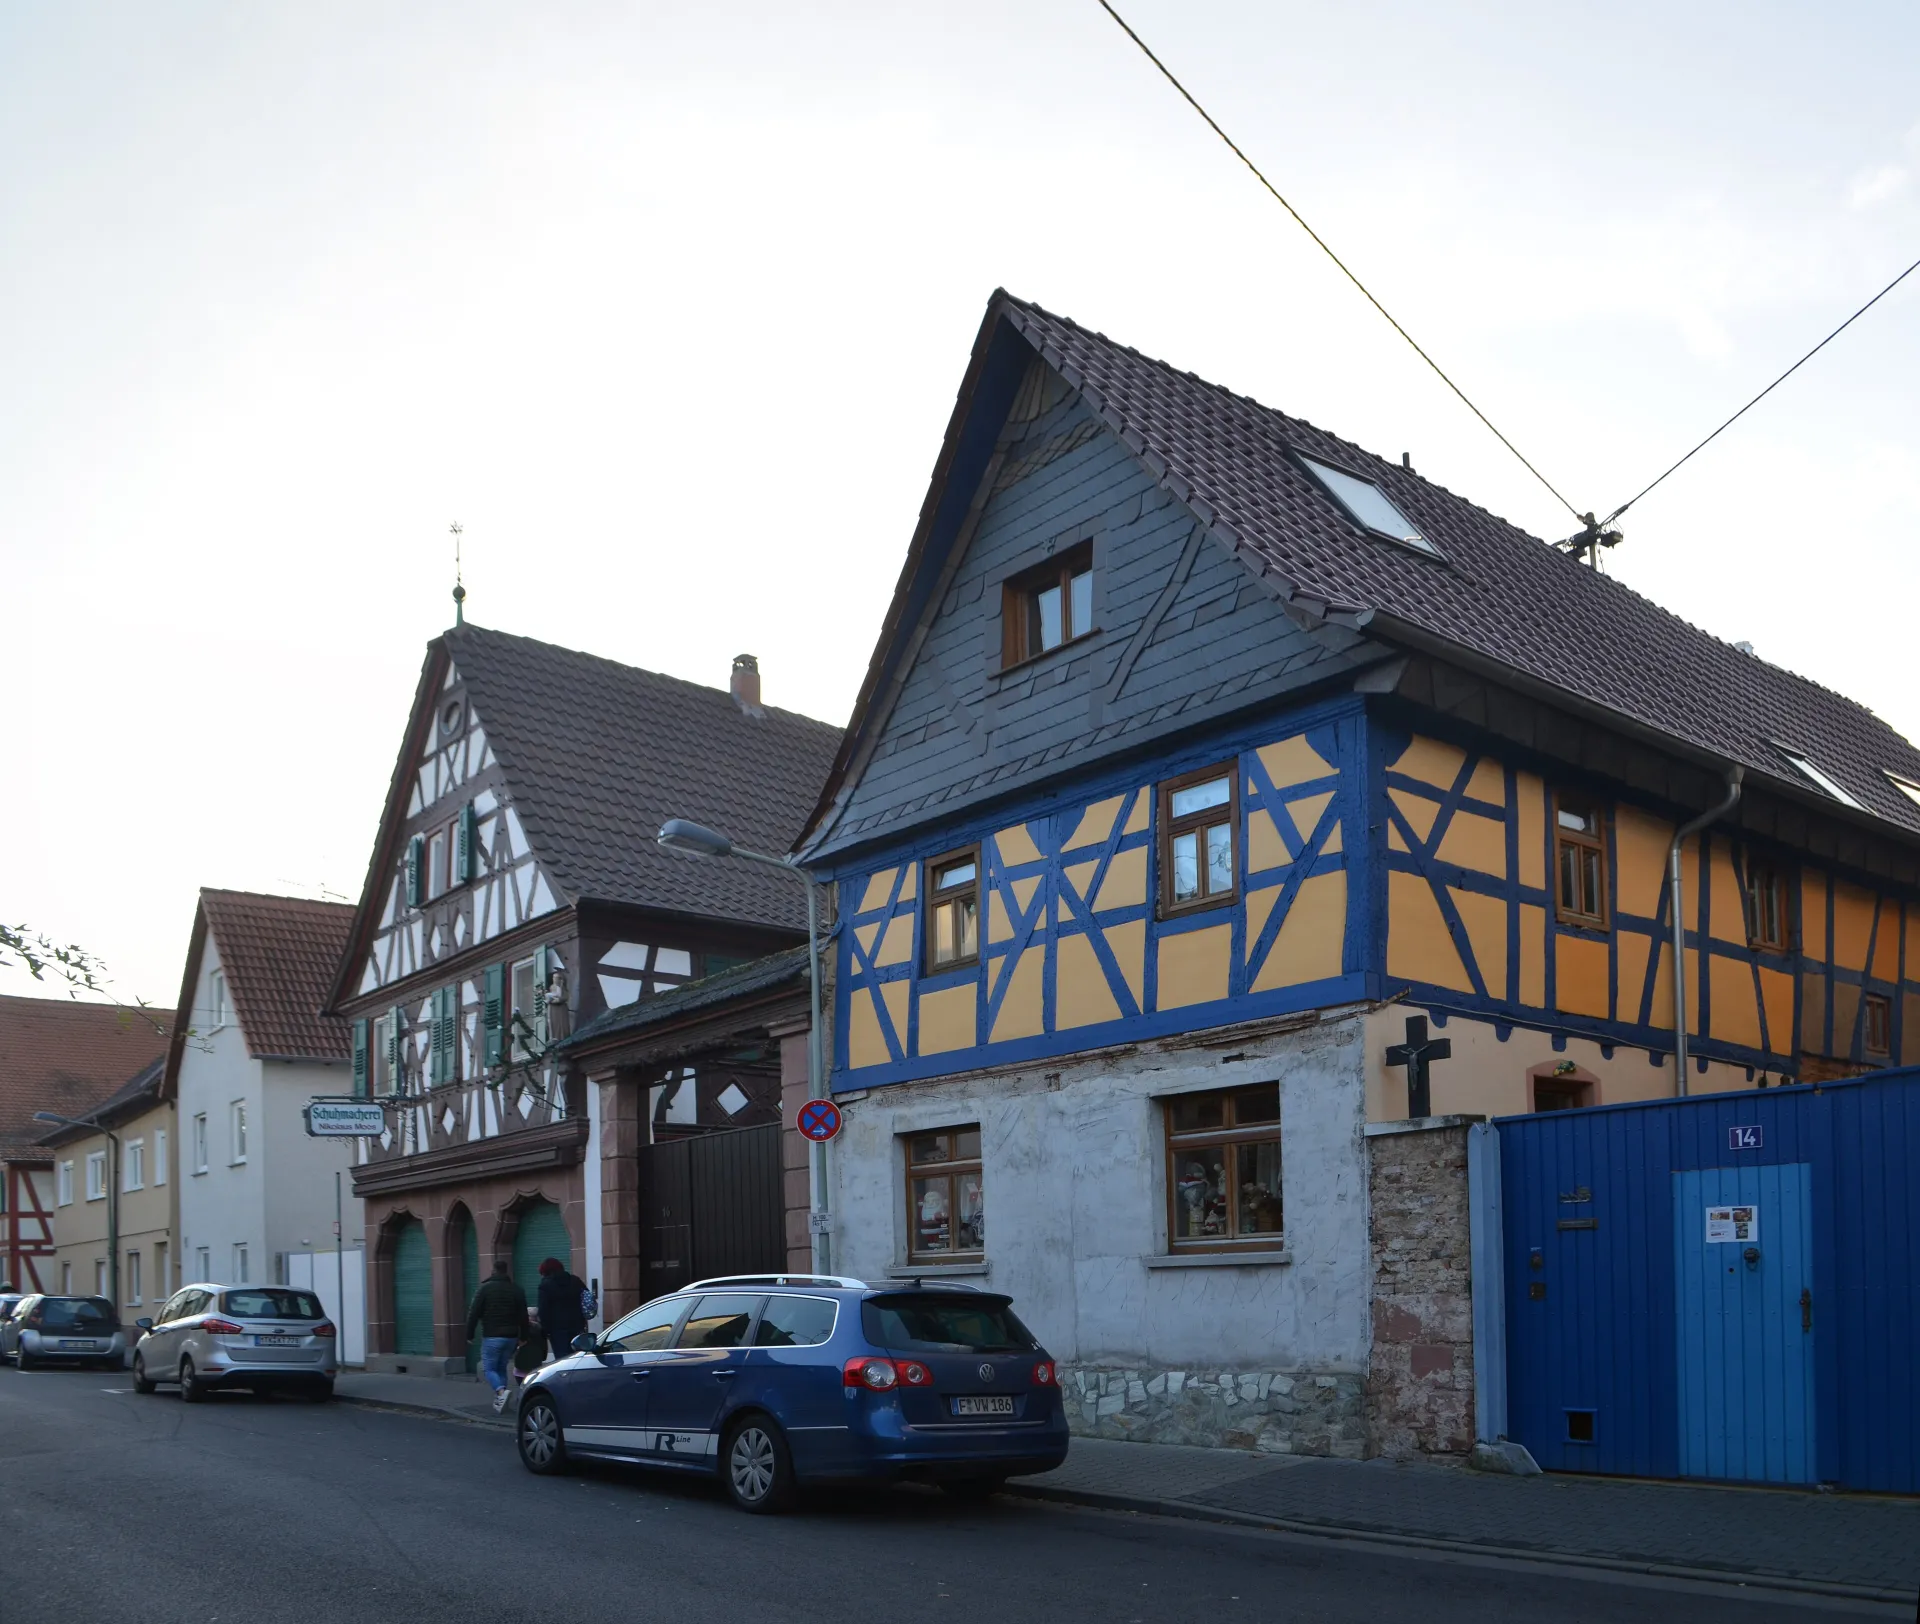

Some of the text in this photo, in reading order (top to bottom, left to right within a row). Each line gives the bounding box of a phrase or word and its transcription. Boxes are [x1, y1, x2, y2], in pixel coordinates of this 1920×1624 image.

[312, 1107, 381, 1120] Schuhmacherei
[1736, 1129, 1756, 1146] 14
[959, 1398, 1012, 1412] F VW 186
[655, 1433, 690, 1450] R Line
